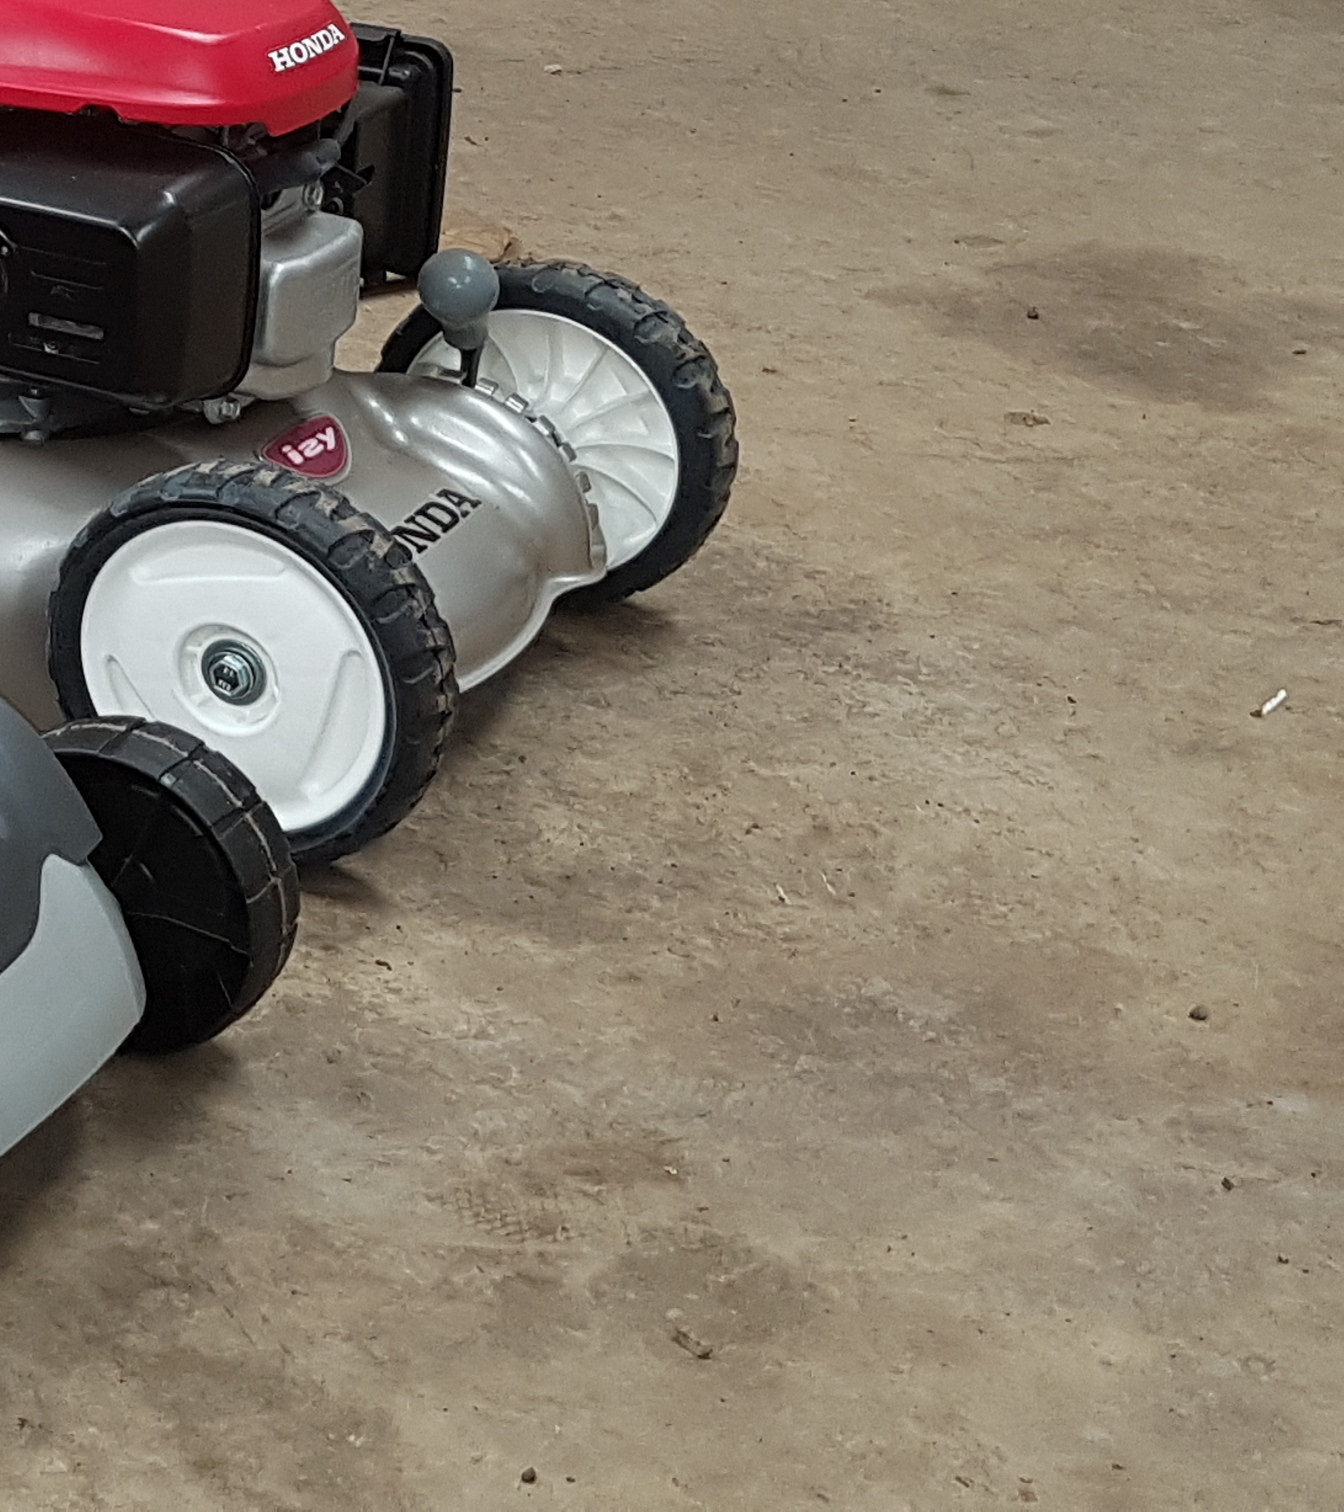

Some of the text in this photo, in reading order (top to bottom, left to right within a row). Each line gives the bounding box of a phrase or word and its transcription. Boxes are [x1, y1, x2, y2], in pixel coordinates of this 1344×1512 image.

[268, 24, 346, 72] HONDA
[282, 427, 335, 465] izy
[391, 489, 482, 554] NDA
